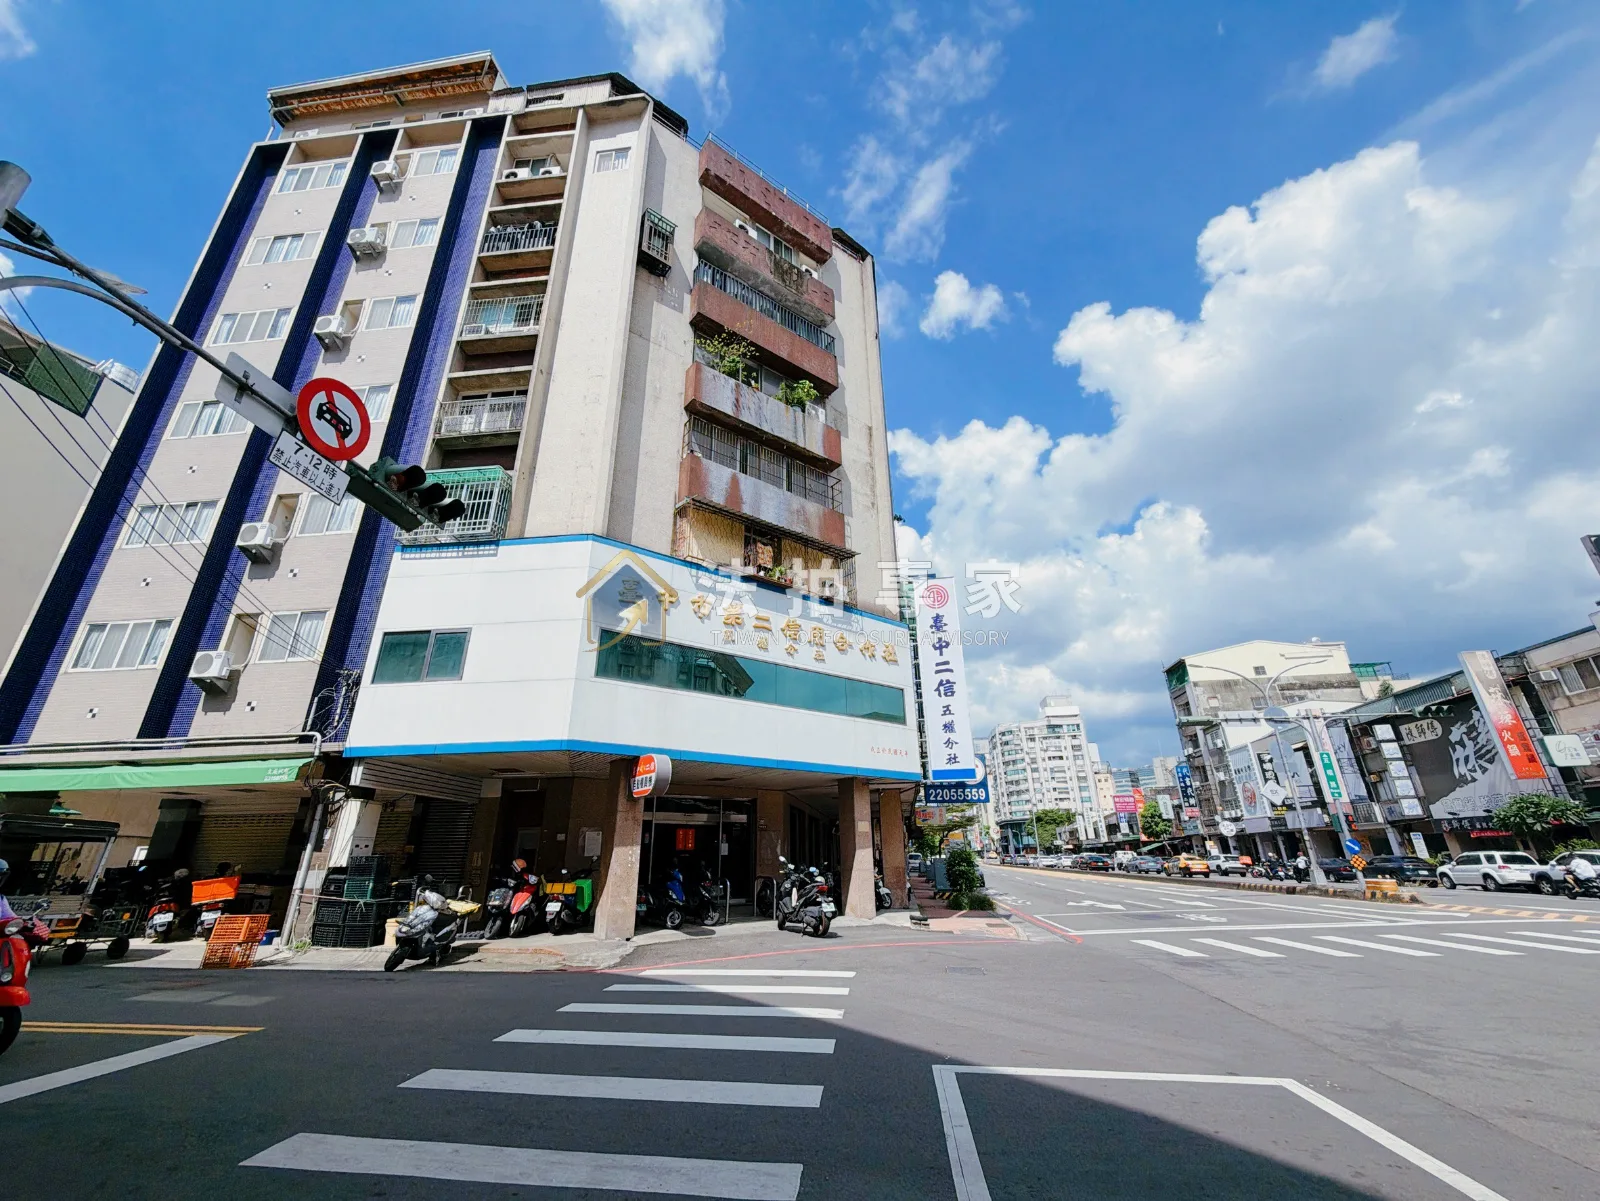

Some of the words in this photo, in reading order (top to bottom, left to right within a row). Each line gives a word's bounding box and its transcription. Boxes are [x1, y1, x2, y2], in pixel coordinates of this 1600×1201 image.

[272, 447, 341, 501] 禁止汽車以上進入
[930, 613, 957, 698] 臺中二信
[940, 704, 961, 766] 五權分社
[928, 787, 986, 801] 22055559
